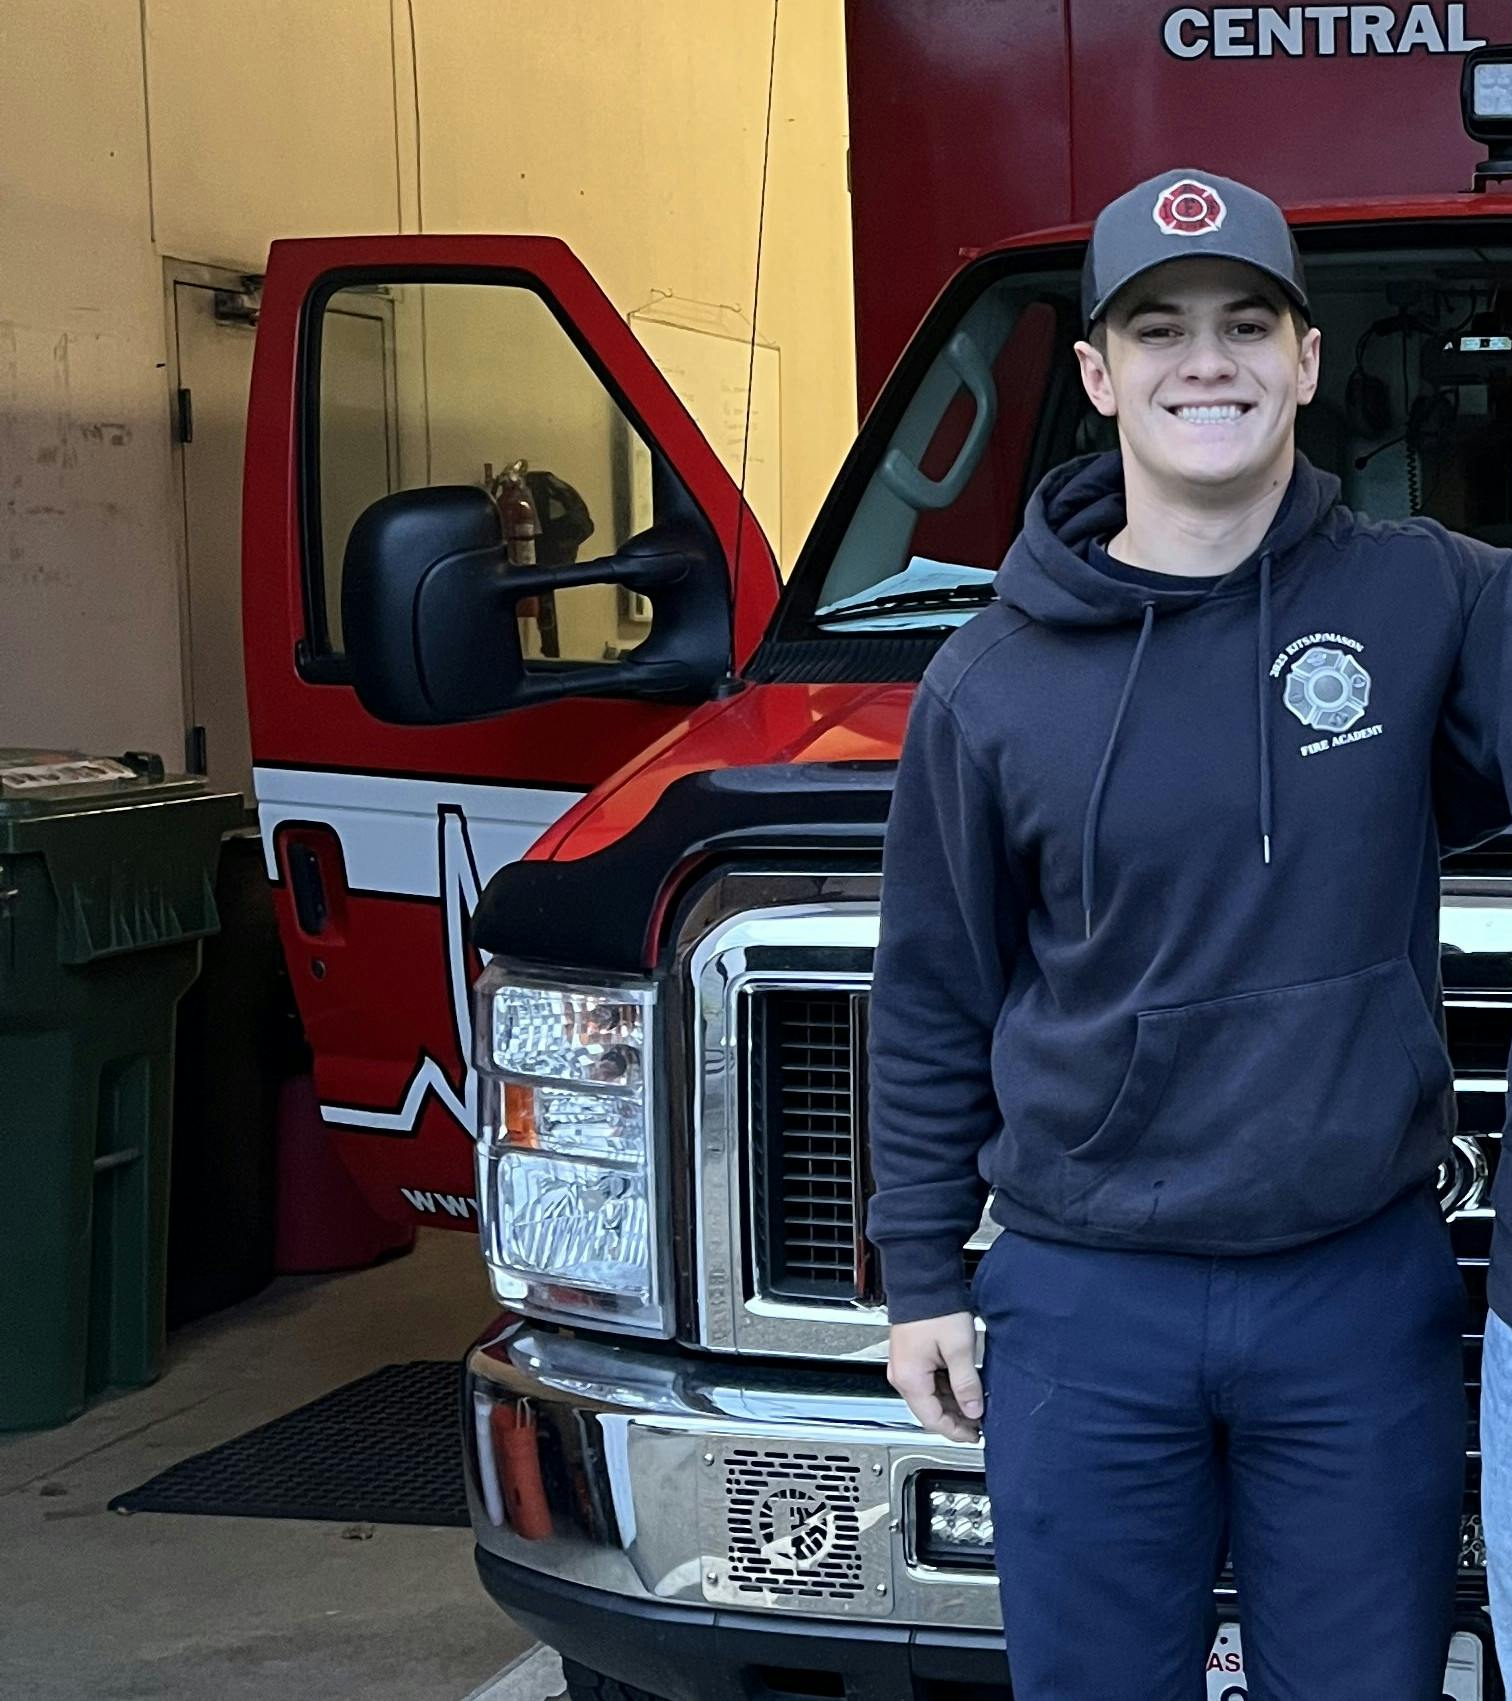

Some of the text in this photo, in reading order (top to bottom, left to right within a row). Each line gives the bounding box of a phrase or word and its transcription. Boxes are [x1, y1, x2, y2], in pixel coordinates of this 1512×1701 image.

[1163, 3, 1488, 58] CENTRAL
[1300, 724, 1384, 757] FIRE ACADEMY
[400, 1187, 480, 1218] ww
